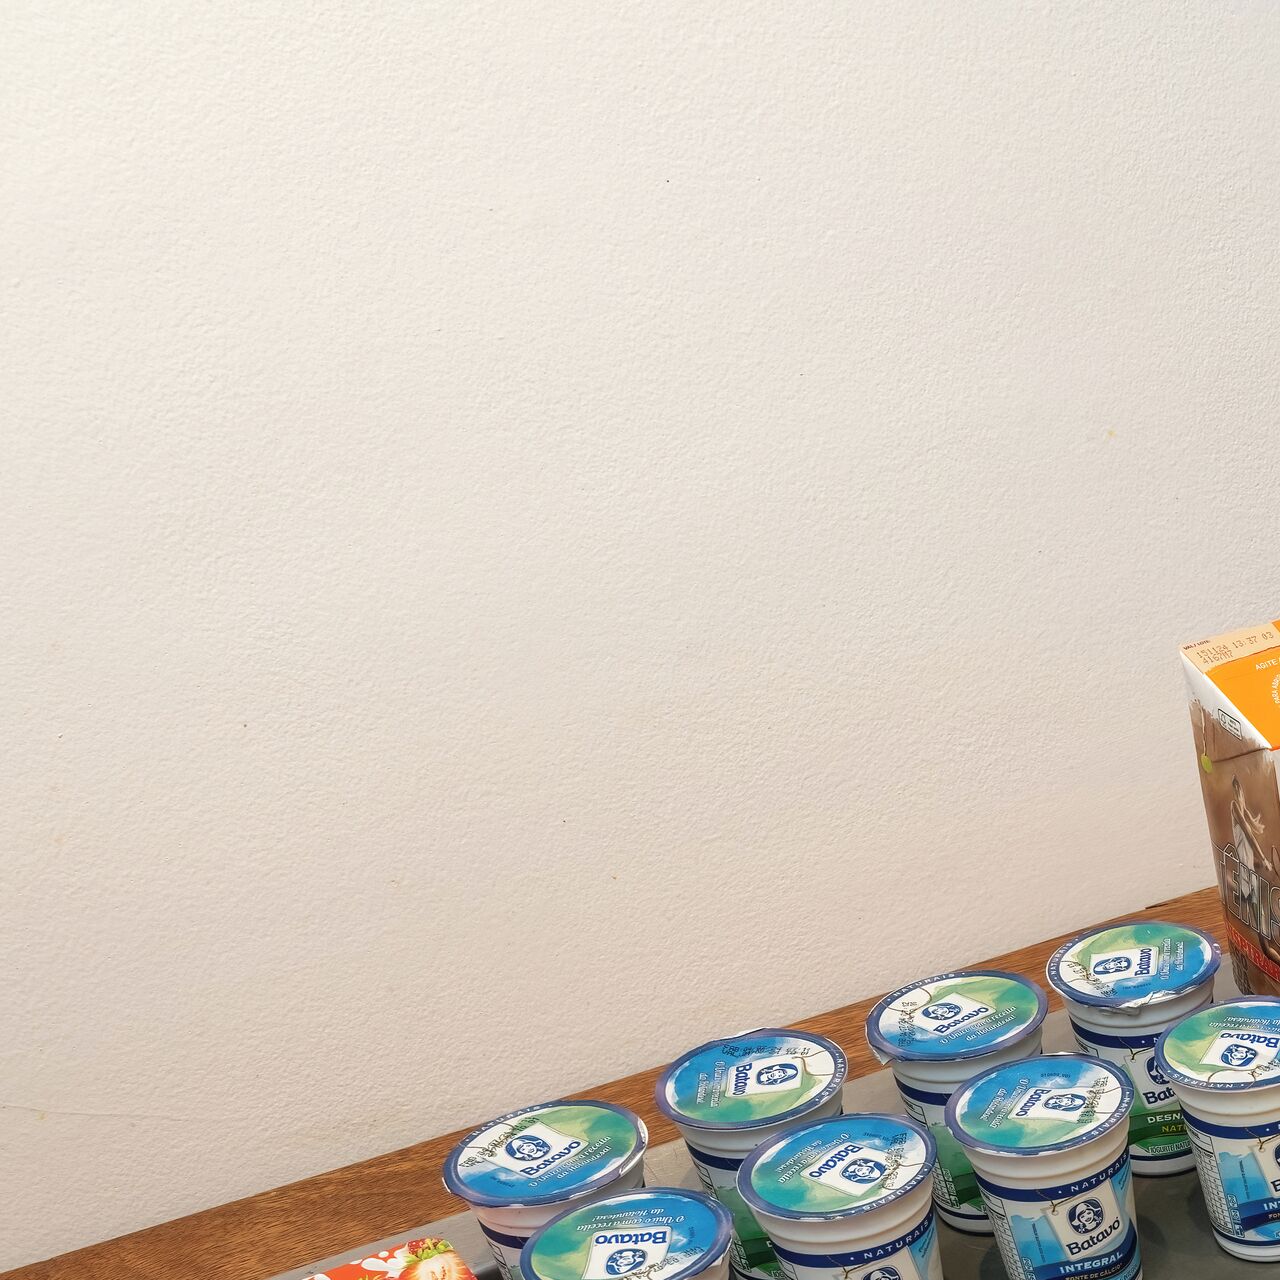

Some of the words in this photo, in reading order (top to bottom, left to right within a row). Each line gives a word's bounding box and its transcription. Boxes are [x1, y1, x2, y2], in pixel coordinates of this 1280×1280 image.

[1255, 659, 1278, 671] AGITE
[1134, 948, 1152, 977] Batavo
[933, 1006, 990, 1034] Batavo
[1220, 1032, 1280, 1049] Batavo
[1172, 1072, 1234, 1088] NATURAIS
[1015, 1089, 1051, 1117] Batavo
[519, 1140, 582, 1176] Batavo
[808, 1144, 865, 1179] Batavo
[1070, 1153, 1129, 1193] NATURAIS
[595, 1230, 668, 1245] Batavo
[863, 1219, 930, 1260] NATURAIS
[1065, 1220, 1121, 1256] Batavo
[1059, 1252, 1123, 1274] INTEGRAL
